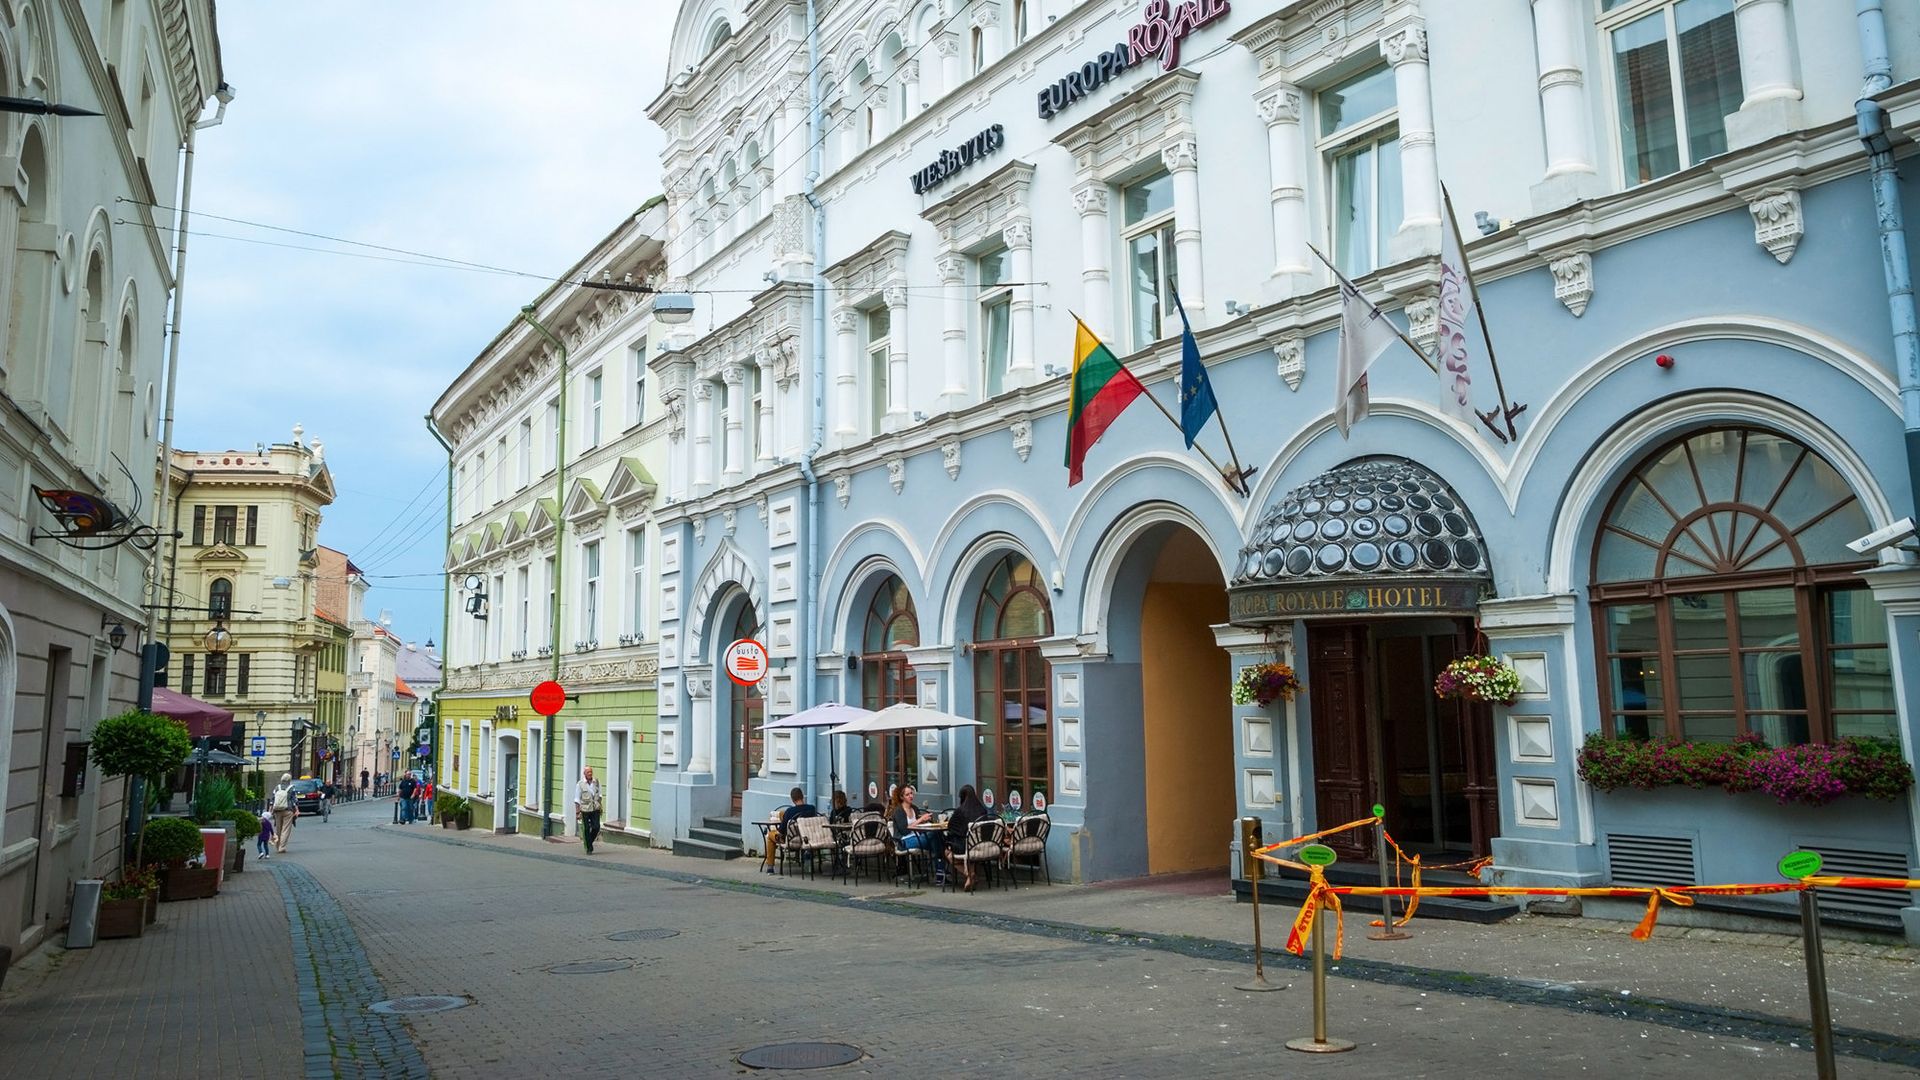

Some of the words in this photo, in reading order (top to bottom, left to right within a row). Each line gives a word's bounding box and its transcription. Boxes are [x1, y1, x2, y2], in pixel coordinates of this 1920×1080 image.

[1037, 43, 1130, 119] EUROPA
[909, 123, 1004, 195] VIEŠBUTIS
[1275, 589, 1344, 613] ROYALE
[1366, 586, 1447, 609] HOTEL
[1298, 902, 1314, 933] STOP
